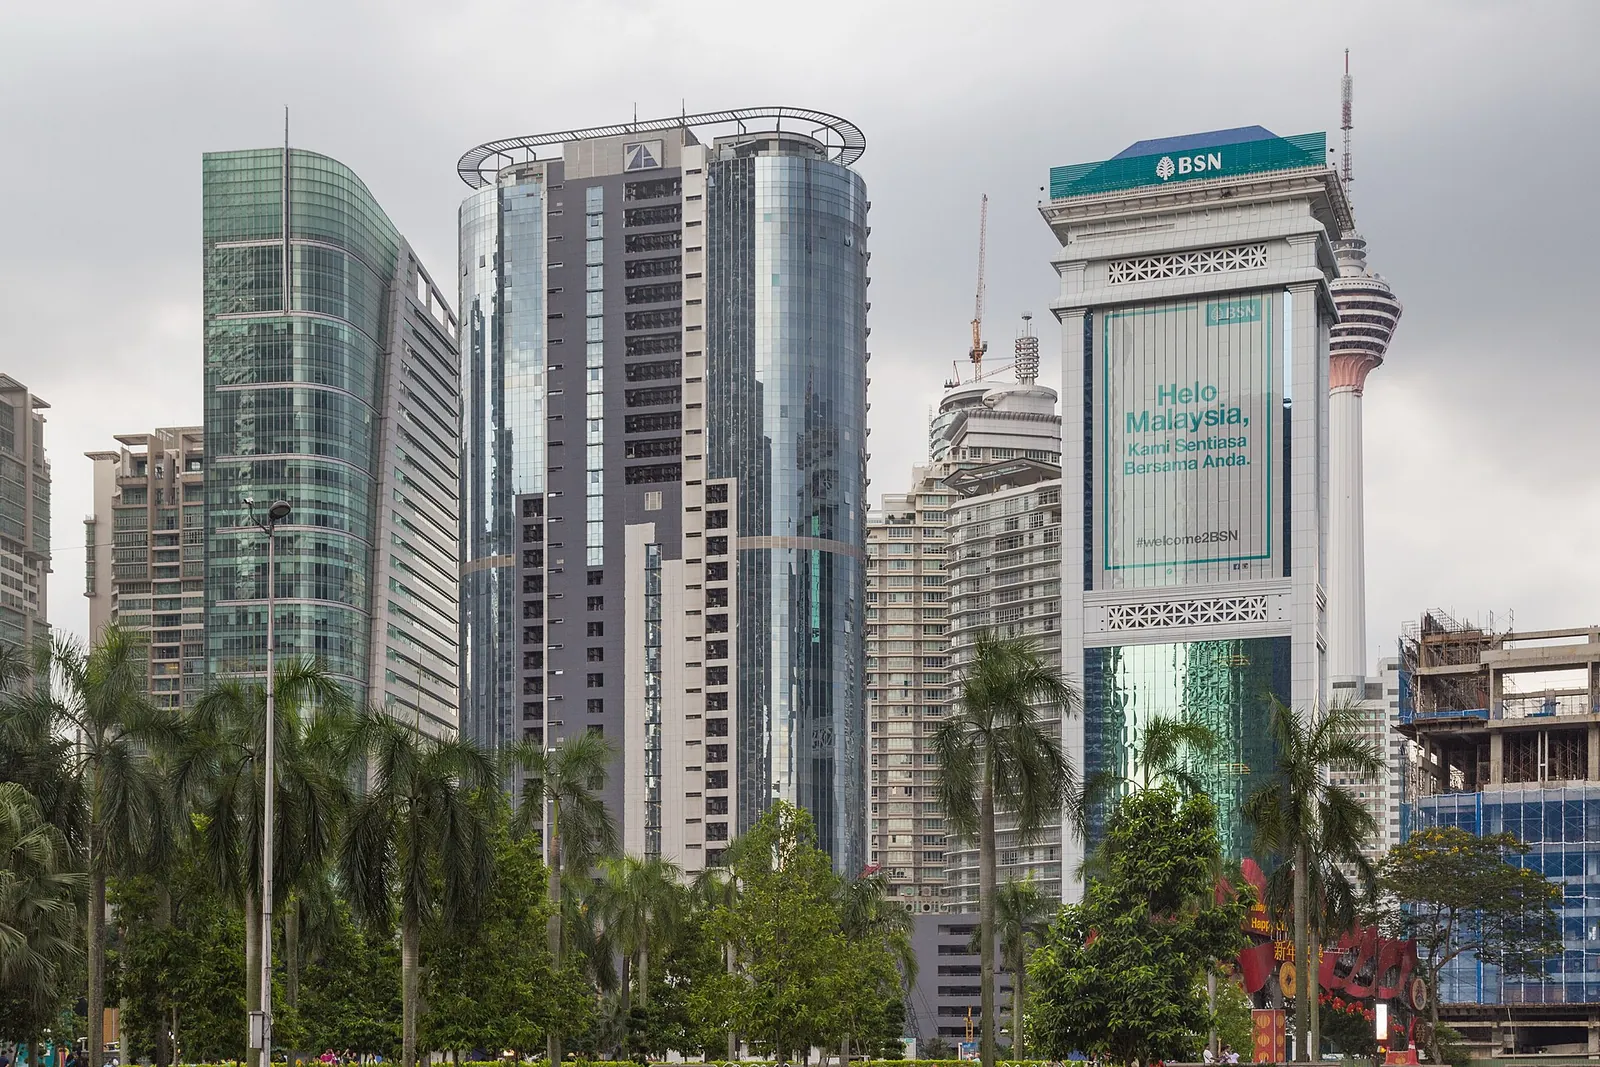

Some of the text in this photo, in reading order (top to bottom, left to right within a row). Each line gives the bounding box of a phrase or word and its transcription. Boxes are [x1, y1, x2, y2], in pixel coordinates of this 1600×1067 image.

[1178, 152, 1222, 174] BSN
[1226, 305, 1256, 319] BSN
[1157, 381, 1217, 406] Helo
[1126, 403, 1249, 434] Malaysia,
[1128, 434, 1247, 457] Kami Sentiasa
[1124, 453, 1251, 476] Bersama Anda.
[1136, 530, 1238, 548] #welcome2BSN
